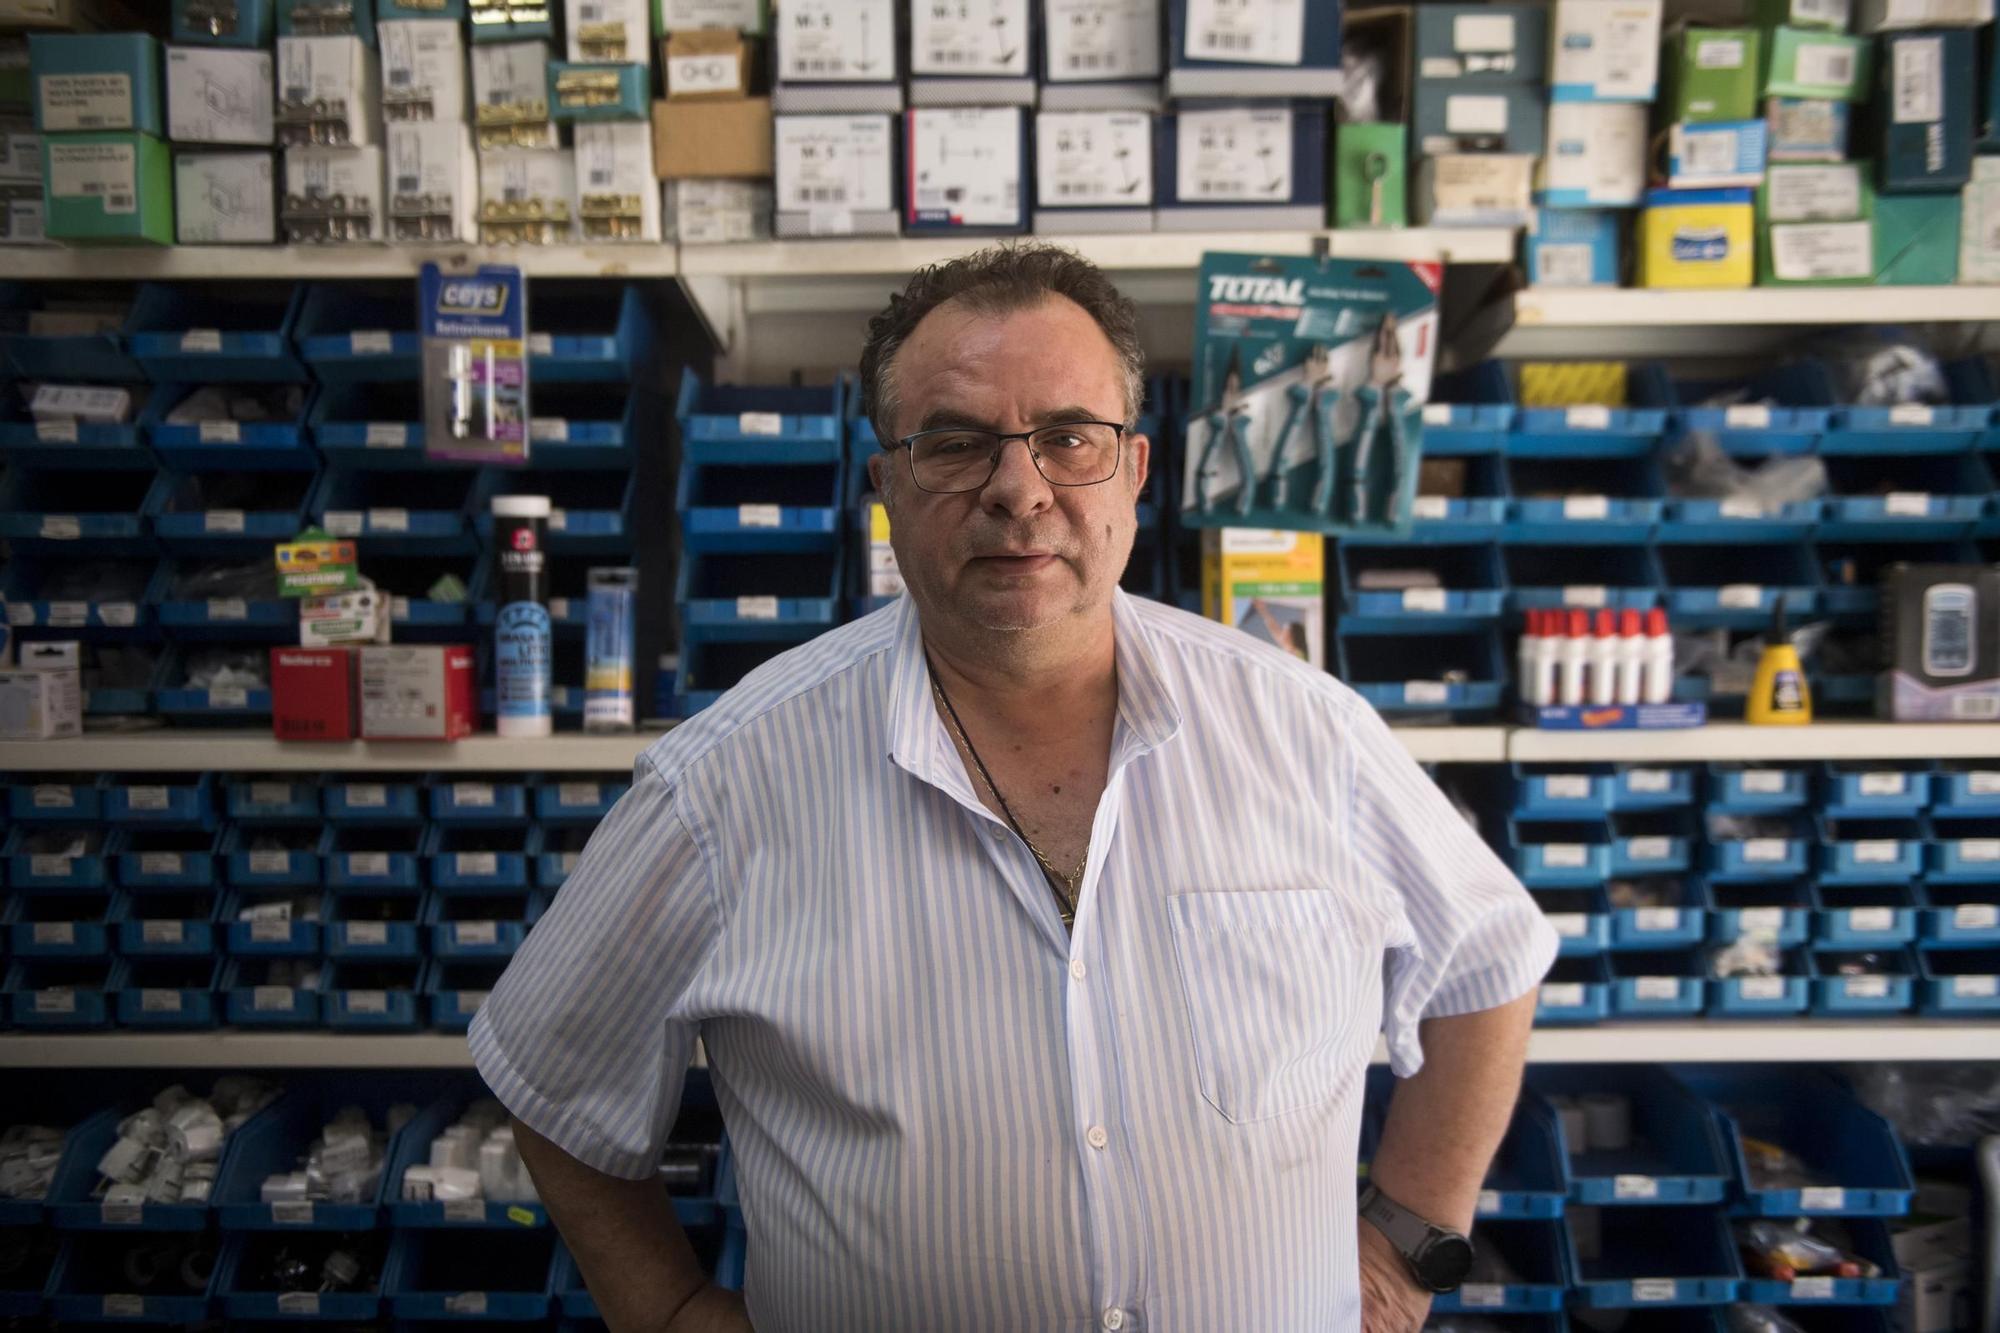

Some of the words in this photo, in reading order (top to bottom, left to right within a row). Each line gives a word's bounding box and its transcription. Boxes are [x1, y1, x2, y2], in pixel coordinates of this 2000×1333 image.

[444, 283, 498, 308] ceys
[1209, 274, 1305, 305] TOTAL
[435, 320, 510, 337] Retrovisores
